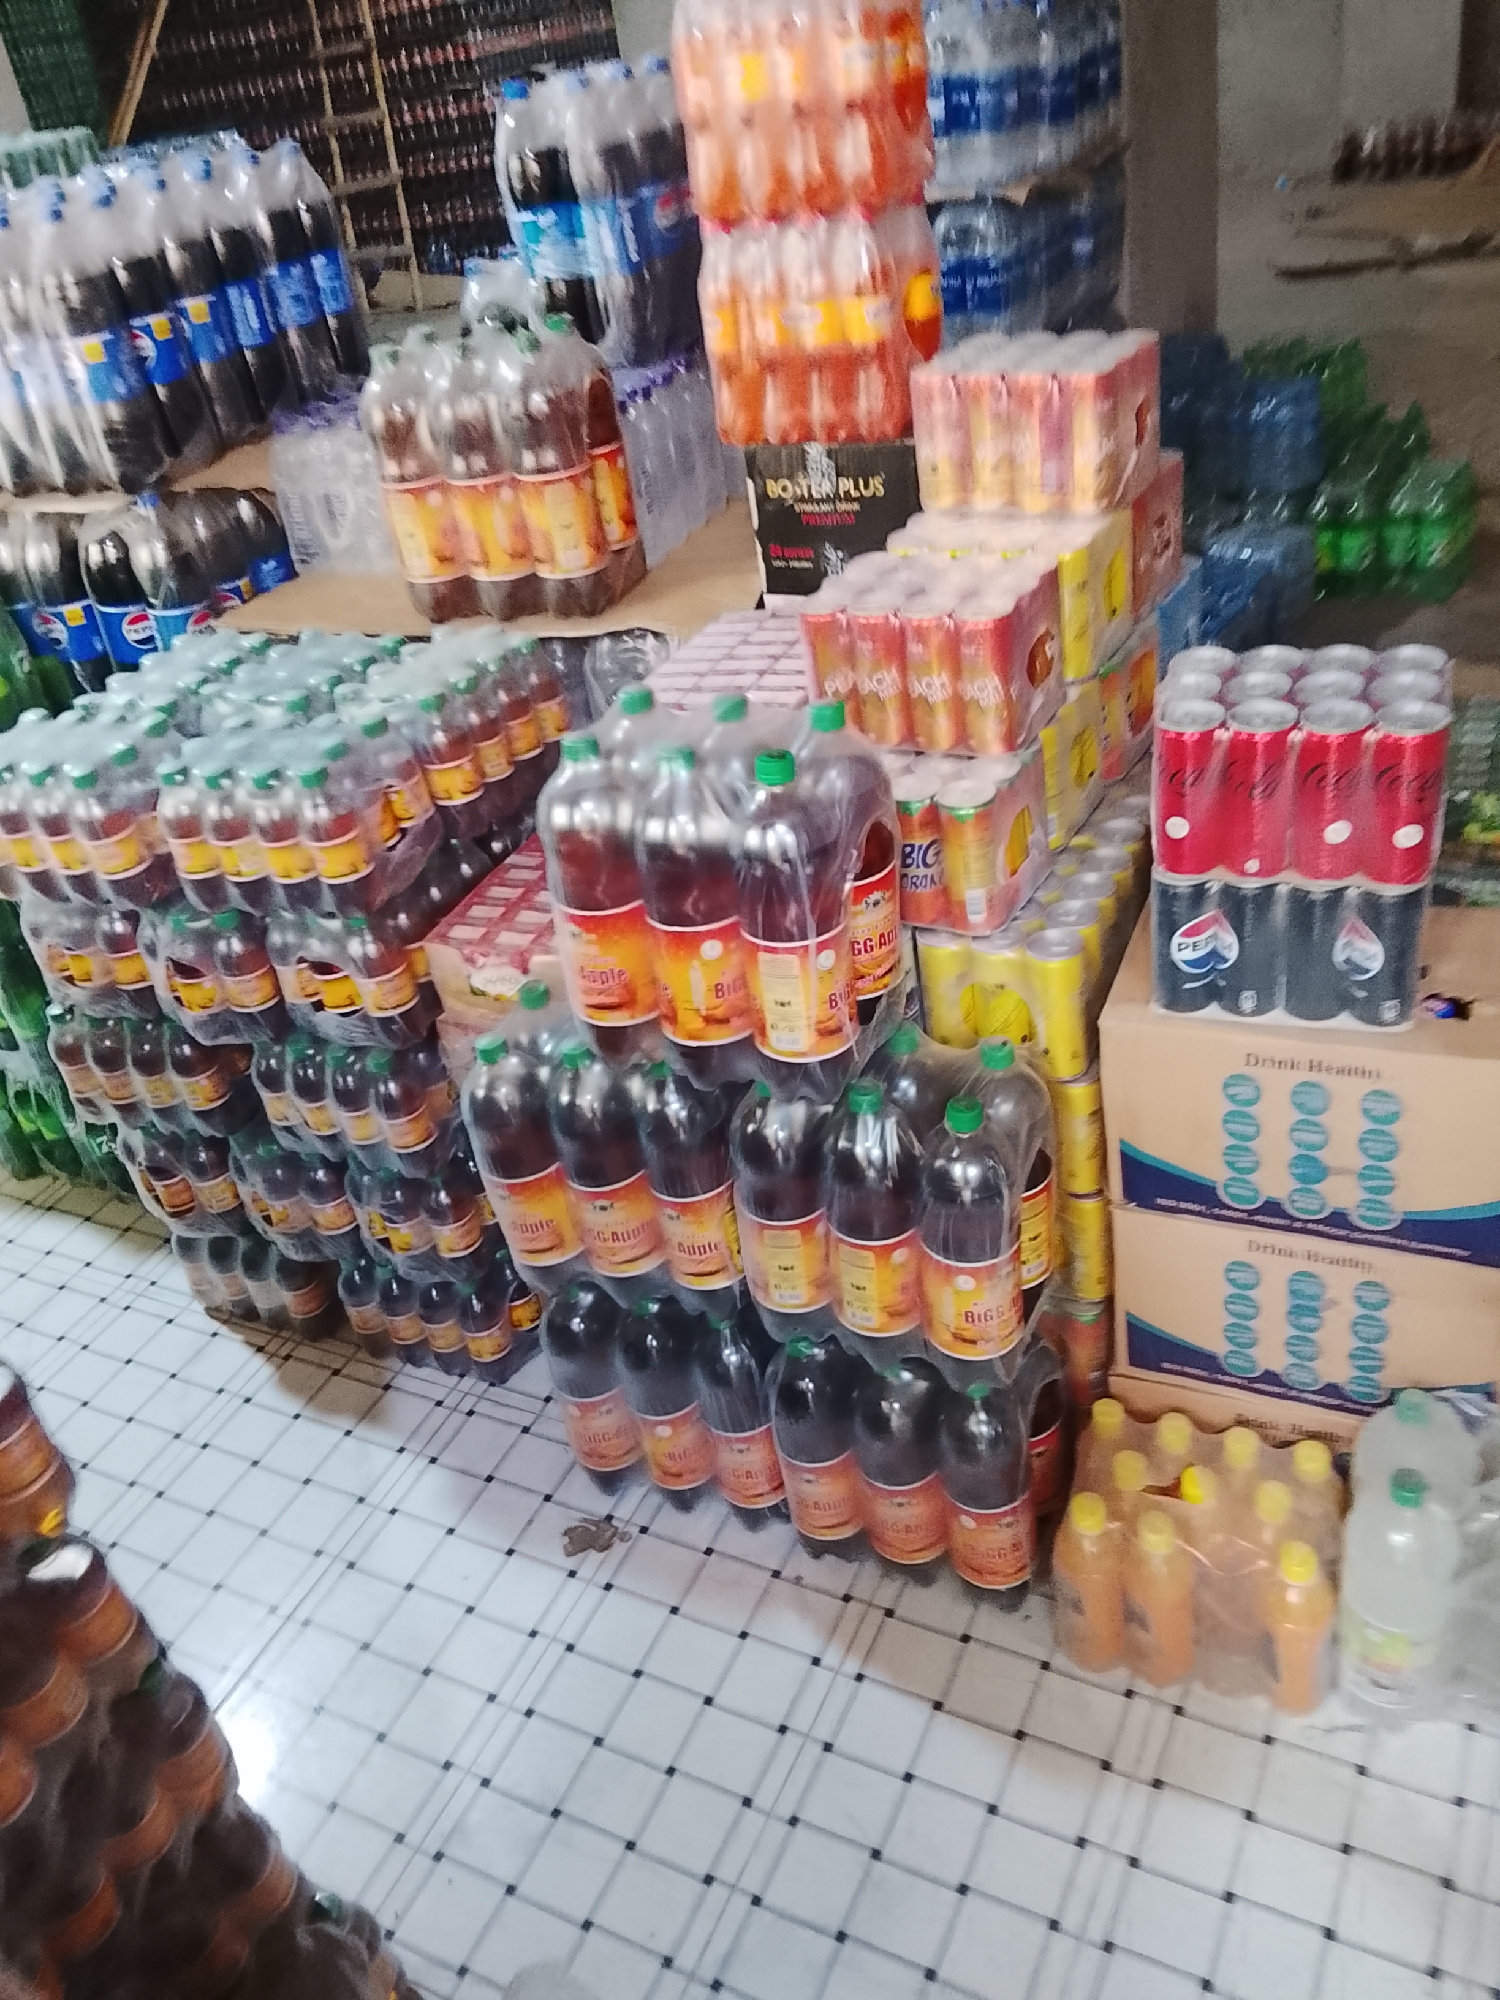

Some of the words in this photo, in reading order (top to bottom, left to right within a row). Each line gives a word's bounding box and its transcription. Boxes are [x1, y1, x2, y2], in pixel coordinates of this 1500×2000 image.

[838, 475, 884, 498] PLUS
[902, 838, 941, 869] BIG
[1244, 1052, 1302, 1072] Drink
